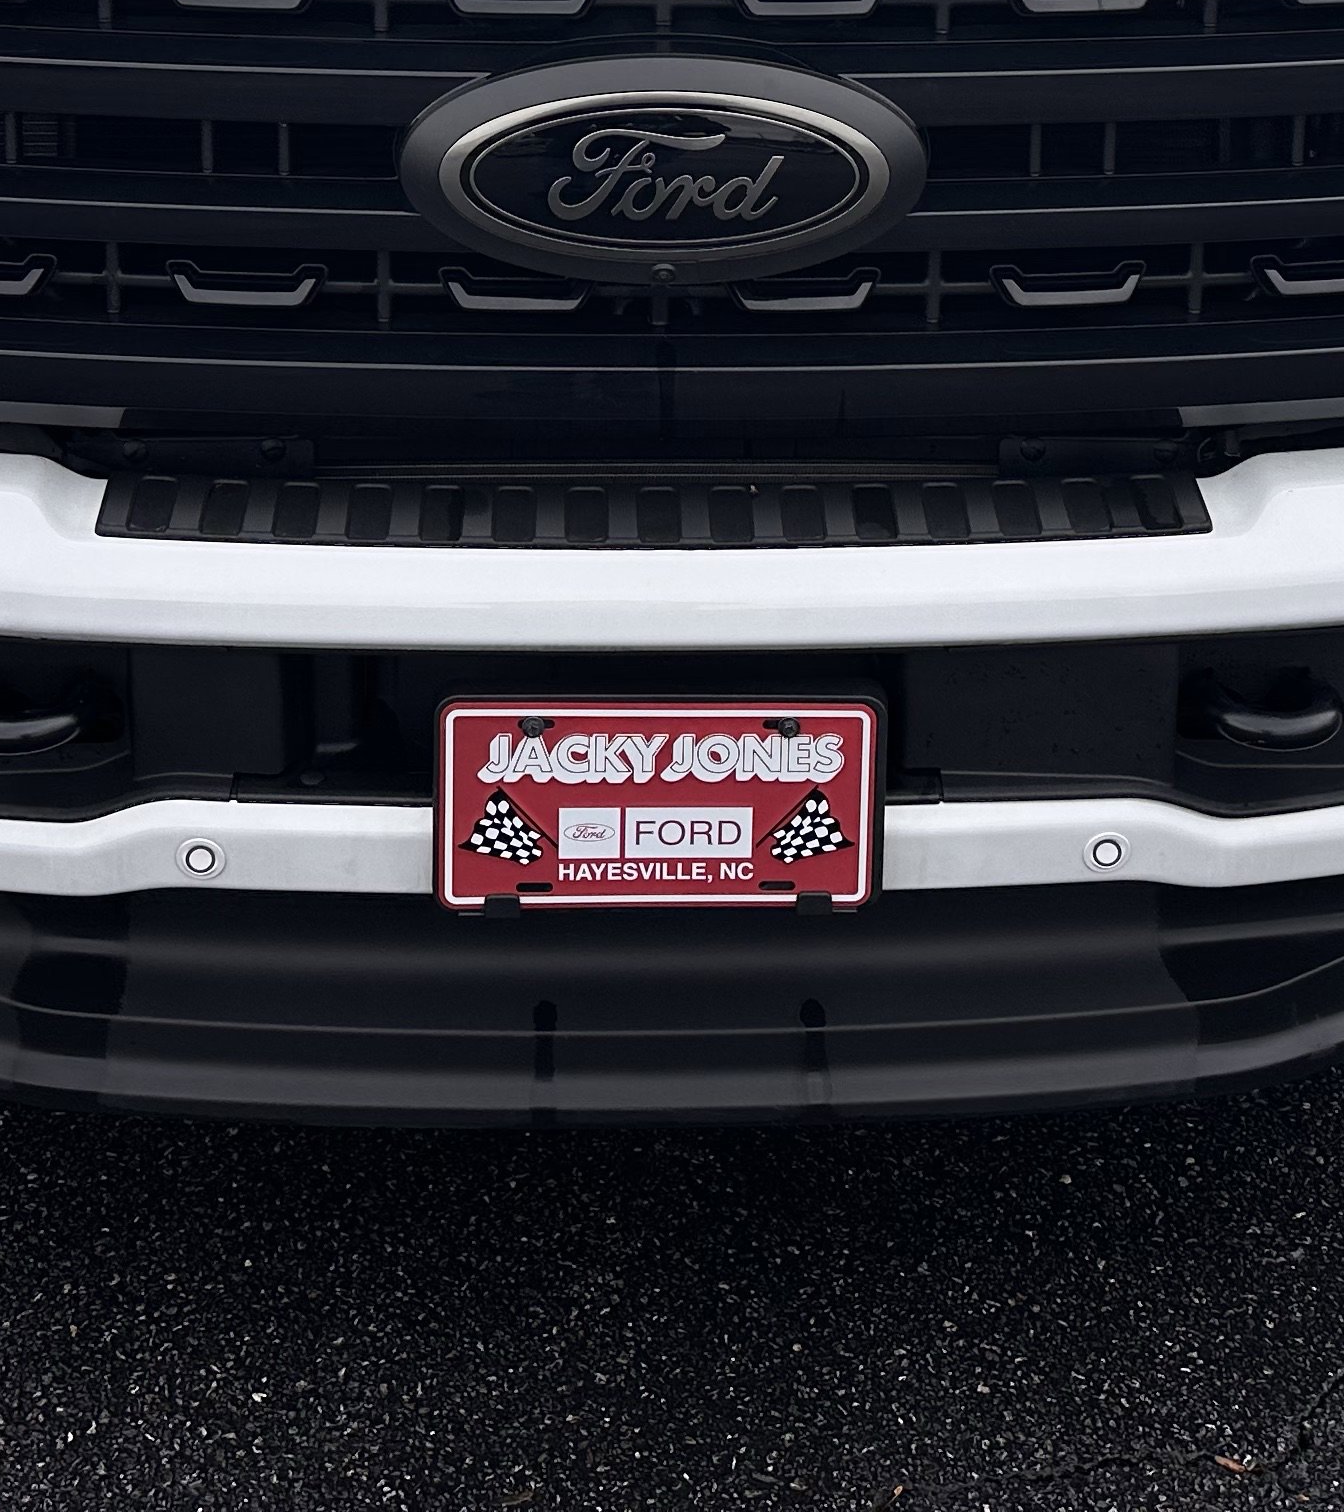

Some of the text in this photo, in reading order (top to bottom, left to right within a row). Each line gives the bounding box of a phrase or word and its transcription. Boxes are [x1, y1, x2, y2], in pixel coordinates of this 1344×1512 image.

[547, 128, 784, 221] Ford
[477, 733, 845, 784] JACKY JONES
[571, 820, 742, 846] Ford FORD
[558, 862, 755, 882] HAYESVILLE, NC
